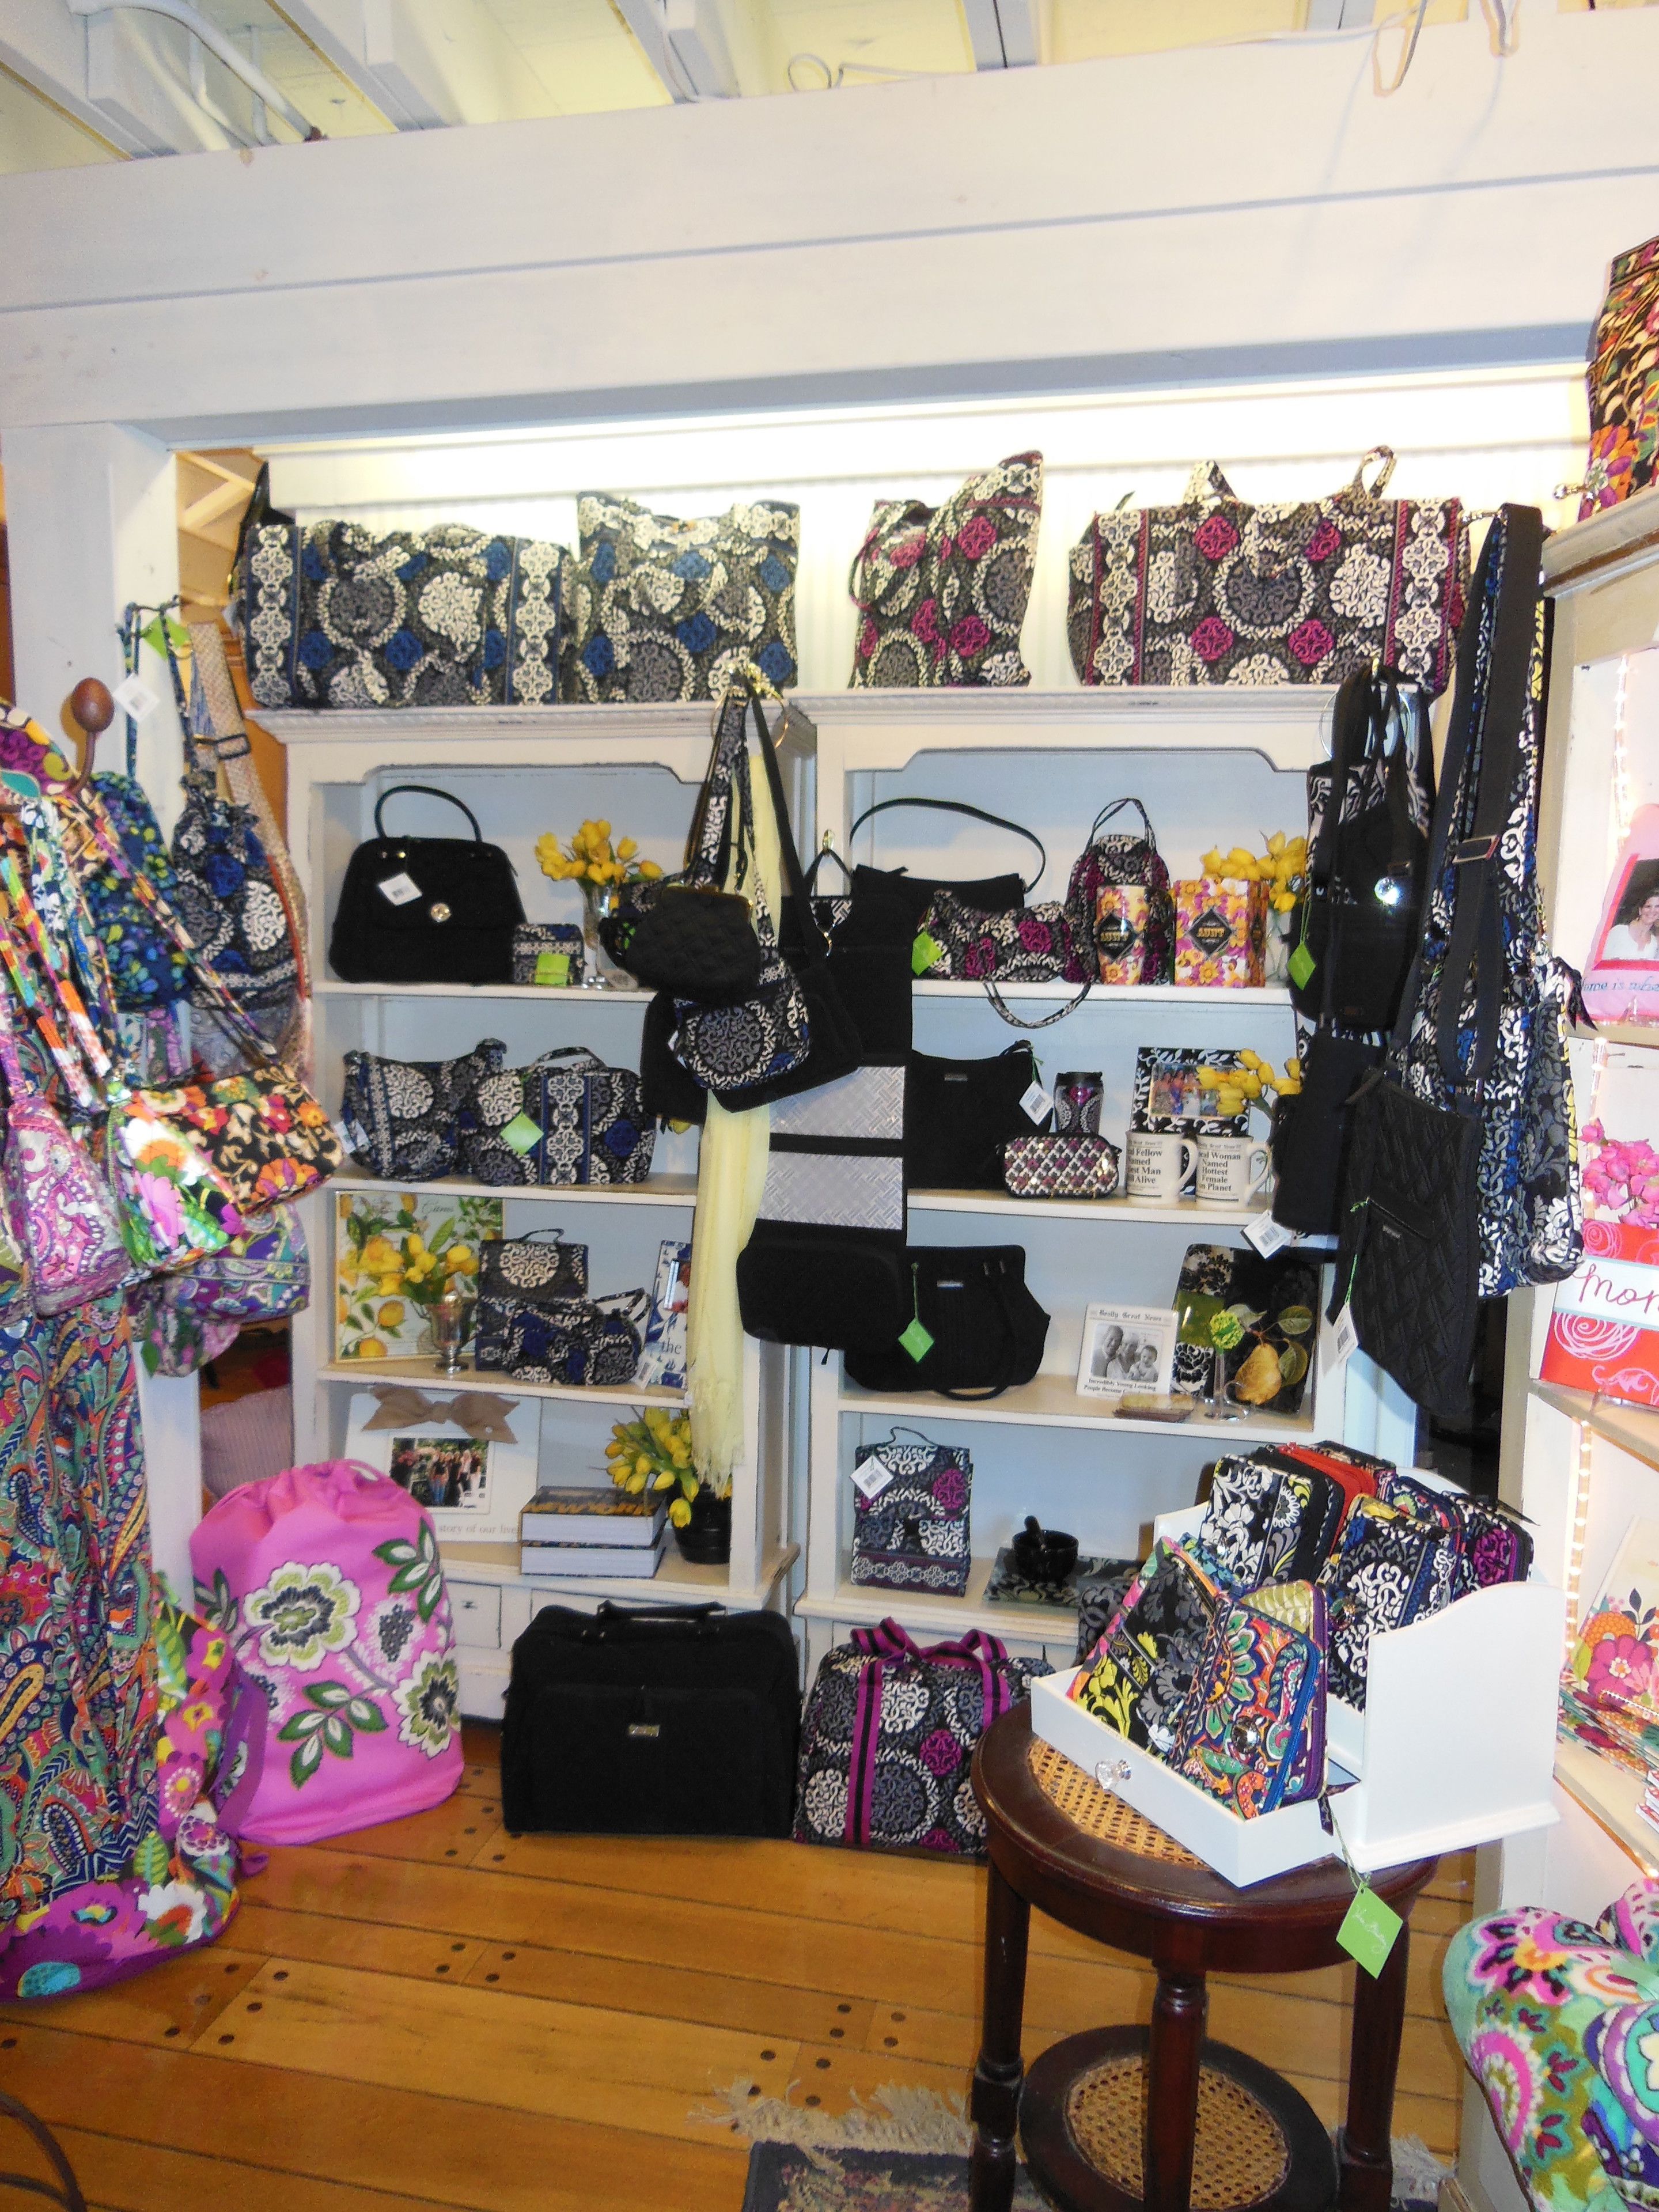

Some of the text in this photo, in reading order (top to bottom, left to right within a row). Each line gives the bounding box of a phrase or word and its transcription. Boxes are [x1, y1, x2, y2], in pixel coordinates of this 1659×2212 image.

[1582, 976, 1659, 991] ome is whe
[1136, 1148, 1162, 1156] Fellow
[1202, 1159, 1228, 1168] Named
[1142, 1167, 1161, 1175] Man
[1202, 1167, 1228, 1176] Hottest
[1135, 1175, 1156, 1184] Alive
[1202, 1175, 1228, 1183] Female
[1207, 1184, 1232, 1192] Planet
[662, 1338, 681, 1354] the
[1134, 1383, 1156, 1392] Looking
[440, 1525, 461, 1535] story
[466, 1523, 477, 1532] of
